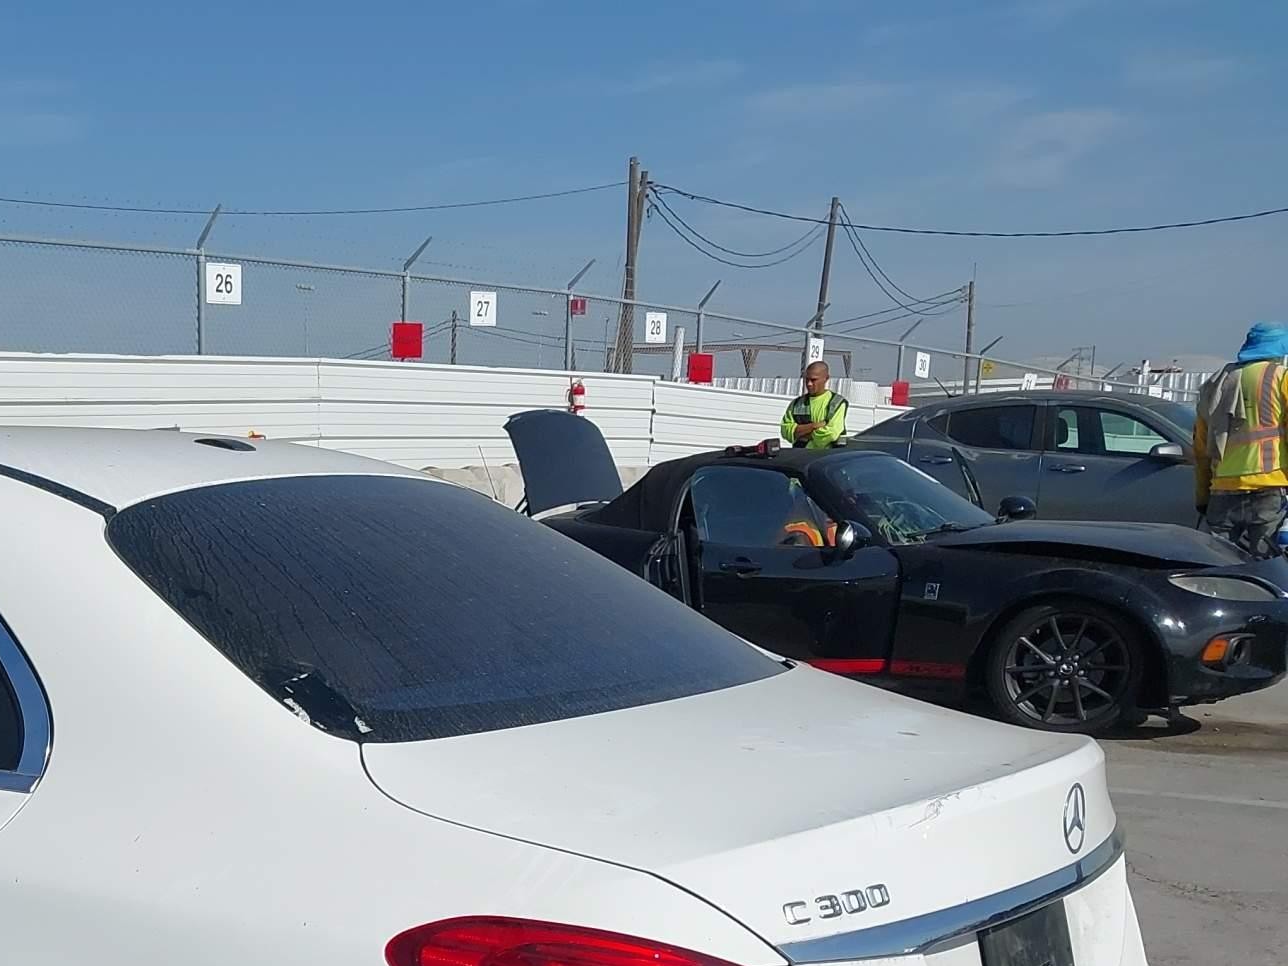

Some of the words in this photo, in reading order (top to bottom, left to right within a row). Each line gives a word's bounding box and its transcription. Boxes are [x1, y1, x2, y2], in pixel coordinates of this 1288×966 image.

[215, 273, 233, 294] 26
[476, 301, 490, 317] 27
[650, 320, 661, 335] 28
[811, 345, 819, 358] 29
[782, 900, 811, 925] C
[815, 883, 891, 919] 300
